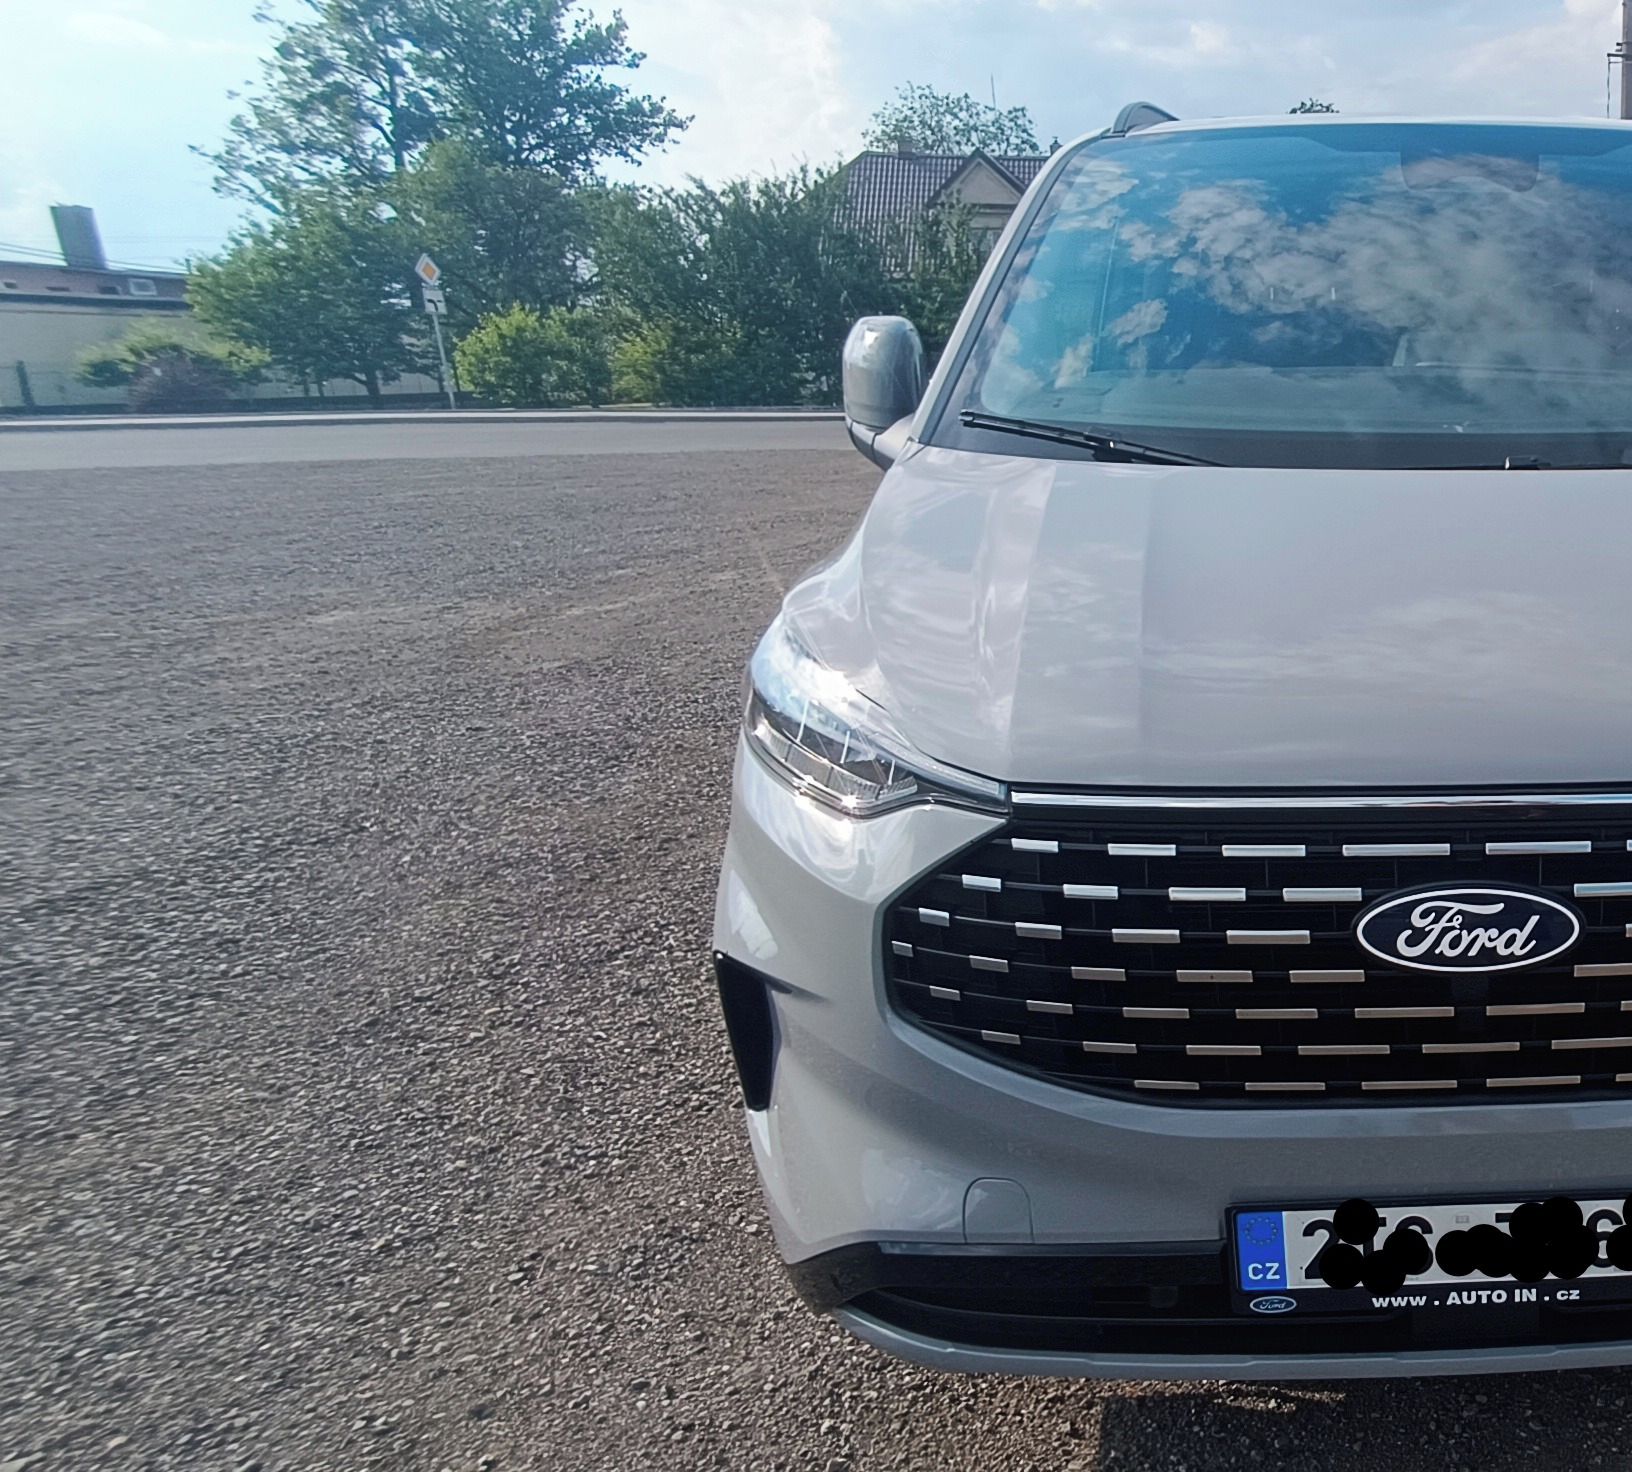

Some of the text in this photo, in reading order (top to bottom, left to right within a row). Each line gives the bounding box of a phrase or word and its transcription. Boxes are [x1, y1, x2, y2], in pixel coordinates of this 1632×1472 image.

[1396, 900, 1540, 957] Ford
[1247, 1262, 1281, 1281] CZ
[1372, 1295, 1427, 1308] www
[1446, 1290, 1508, 1306] AUTO
[1514, 1288, 1537, 1303] IN
